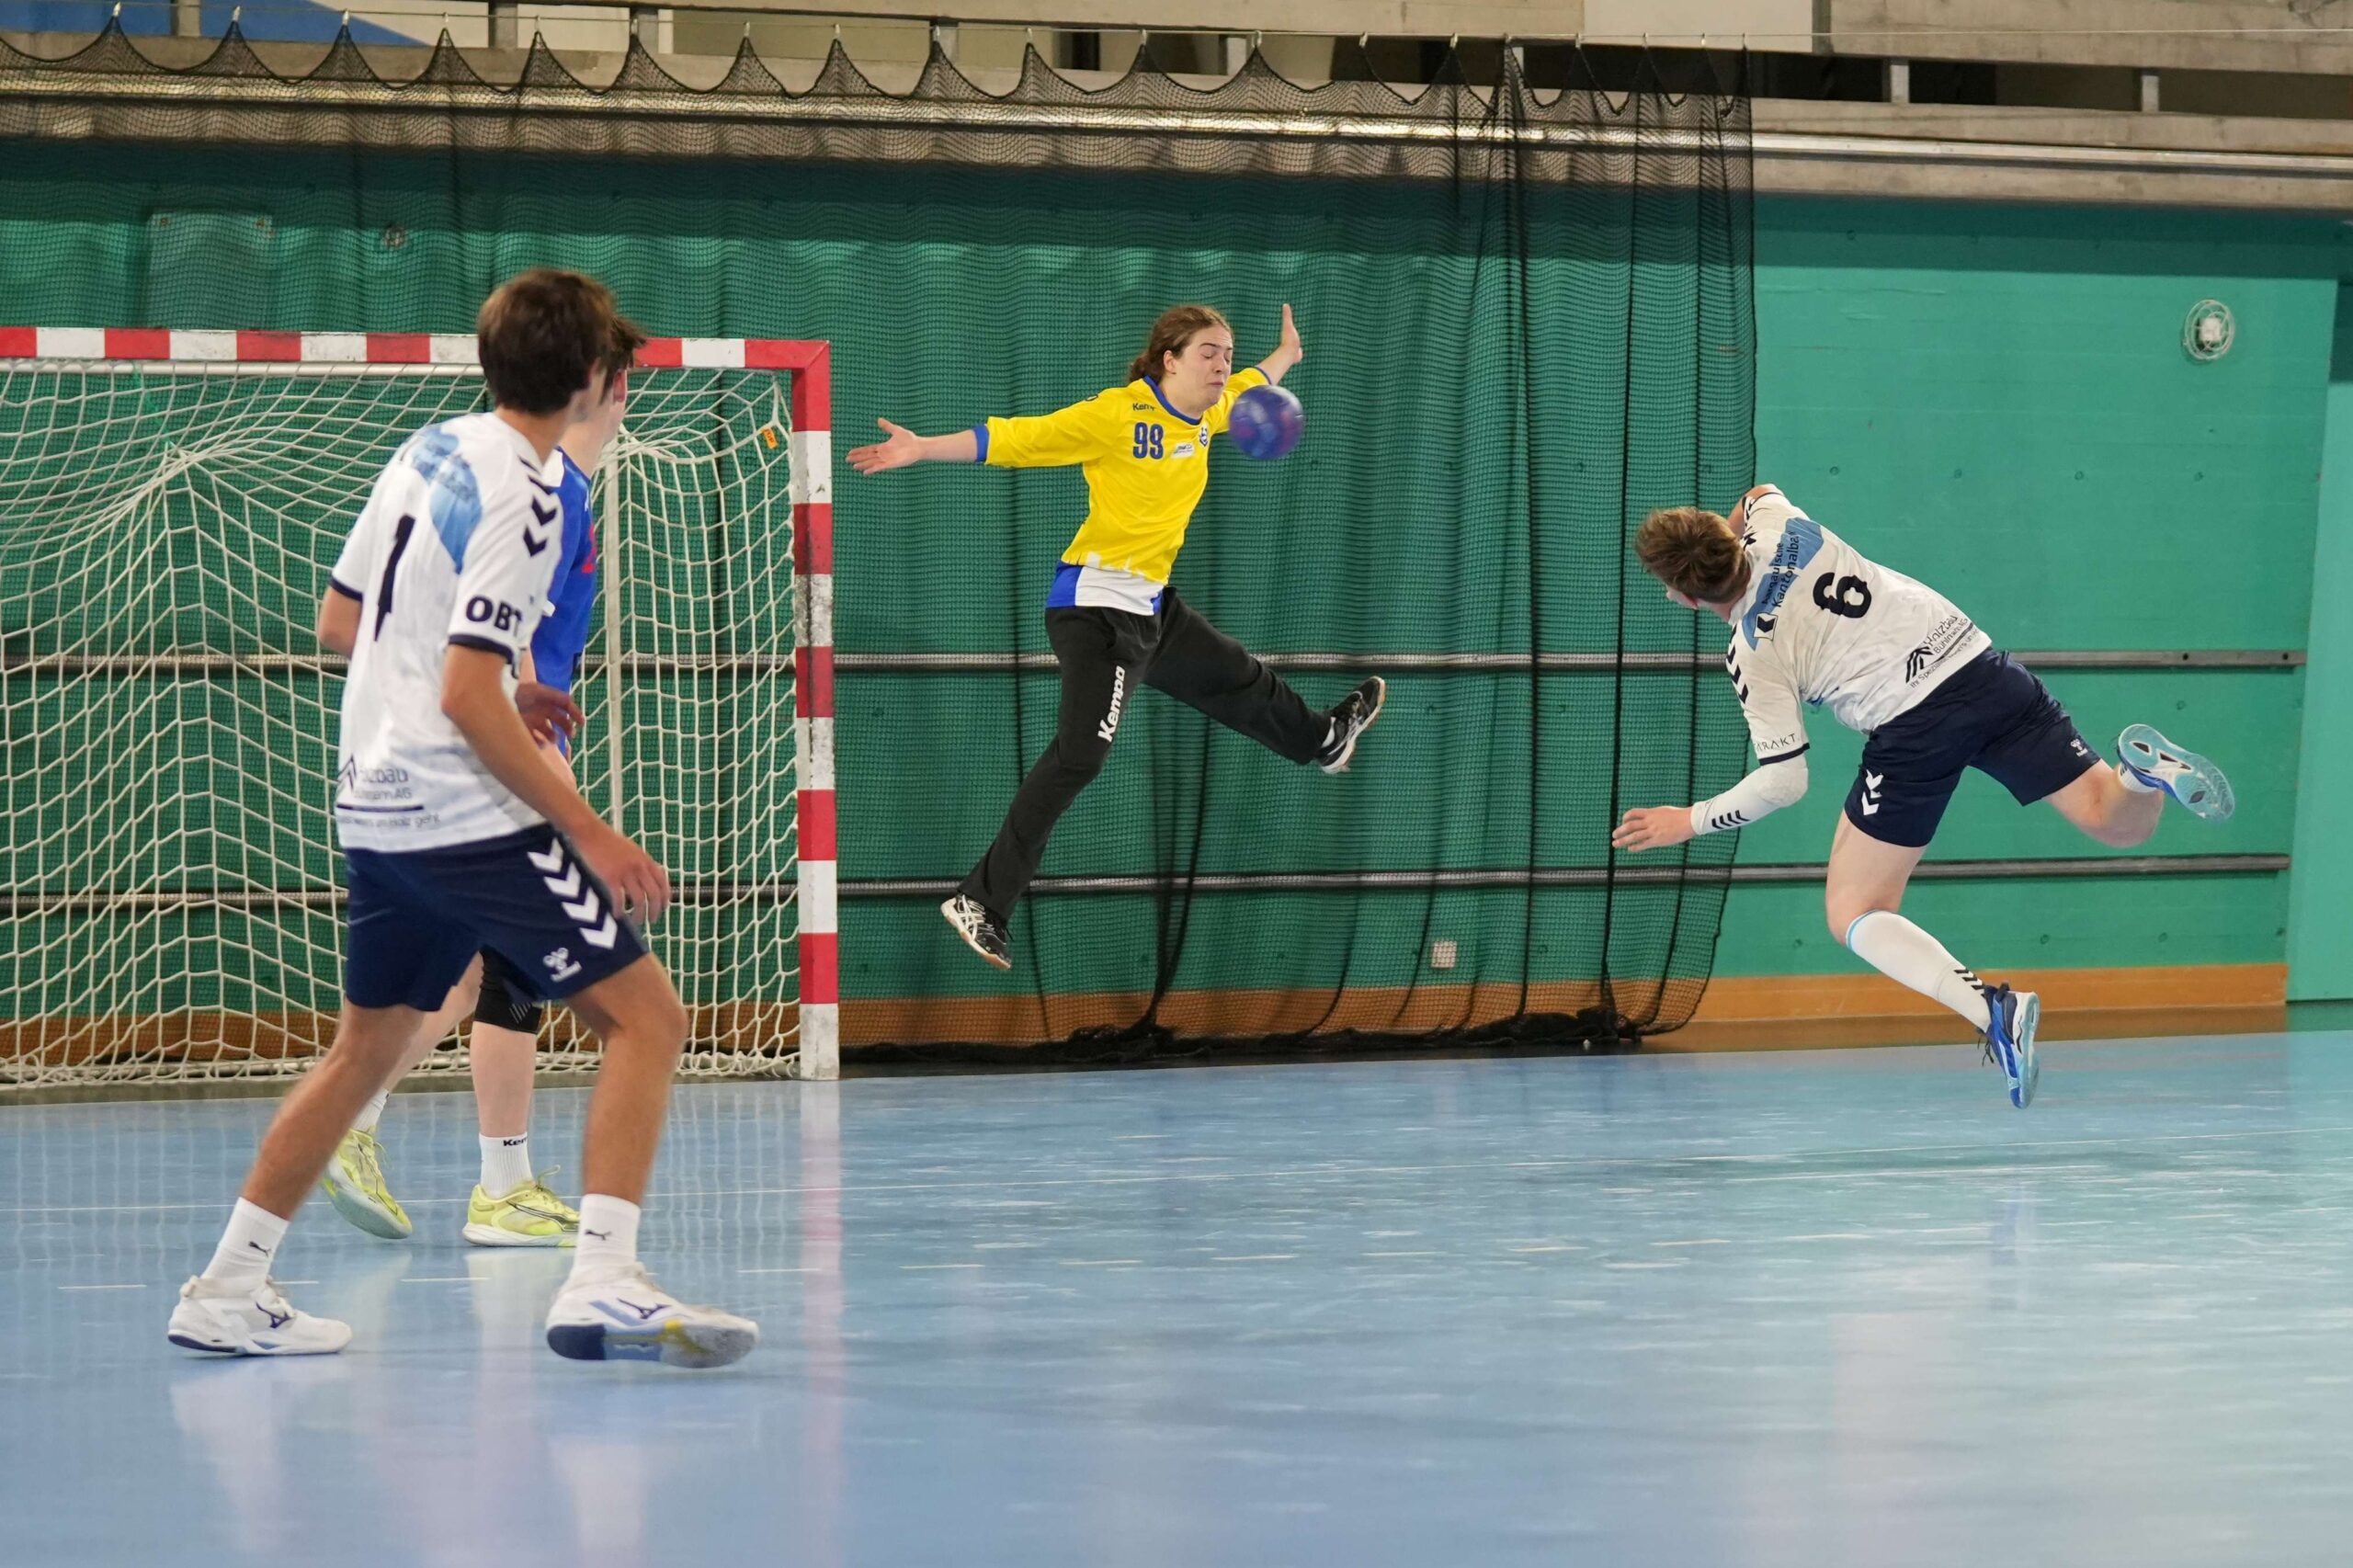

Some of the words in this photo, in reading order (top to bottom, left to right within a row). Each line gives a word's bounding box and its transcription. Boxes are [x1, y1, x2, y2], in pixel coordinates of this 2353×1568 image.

[1132, 422, 1164, 460] 99
[1813, 572, 1872, 619] 6
[1097, 665, 1126, 743] Kempa
